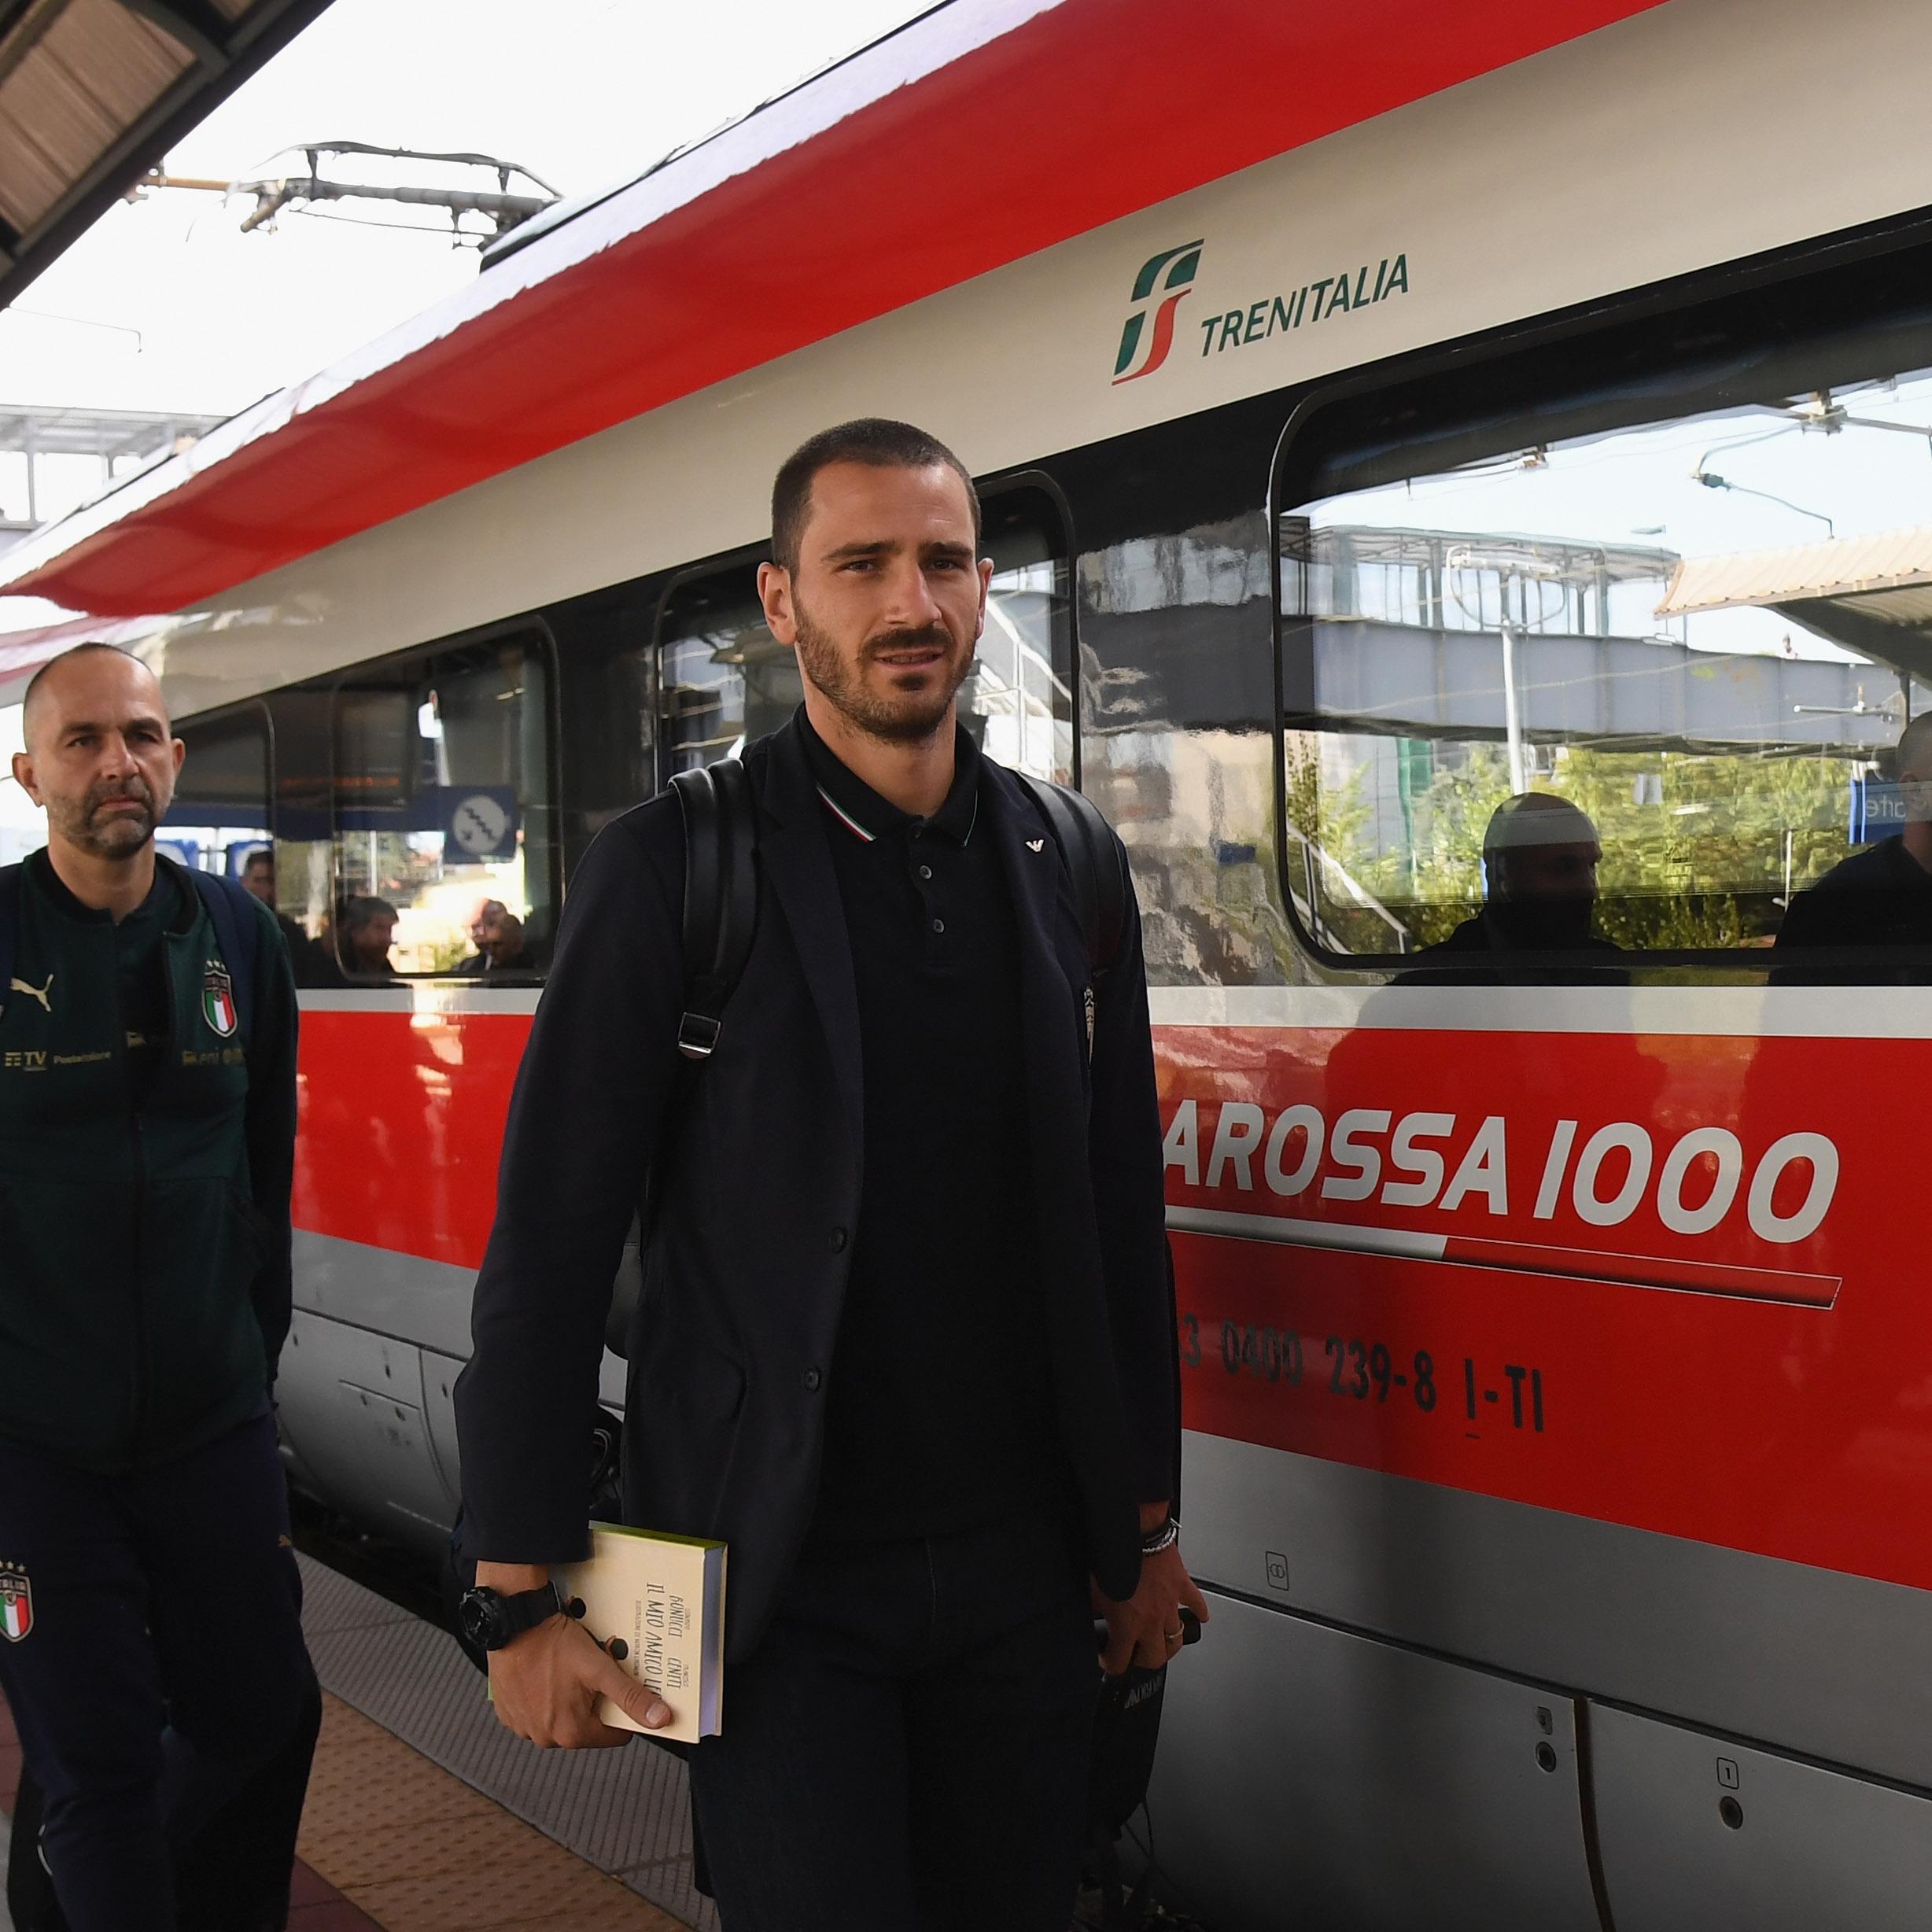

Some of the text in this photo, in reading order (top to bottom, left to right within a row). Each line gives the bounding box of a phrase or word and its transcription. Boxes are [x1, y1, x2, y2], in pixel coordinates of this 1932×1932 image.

[1200, 253, 1408, 357] TRENITALIA
[1163, 1099, 1839, 1243] AROSSA 1000
[1221, 1320, 1303, 1386] 0400
[1325, 1335, 1437, 1413] 239-8
[647, 1582, 665, 1594] IL
[645, 1599, 665, 1628] MIO
[669, 1595, 684, 1638] BONUCCI
[643, 1631, 663, 1675] AMICO
